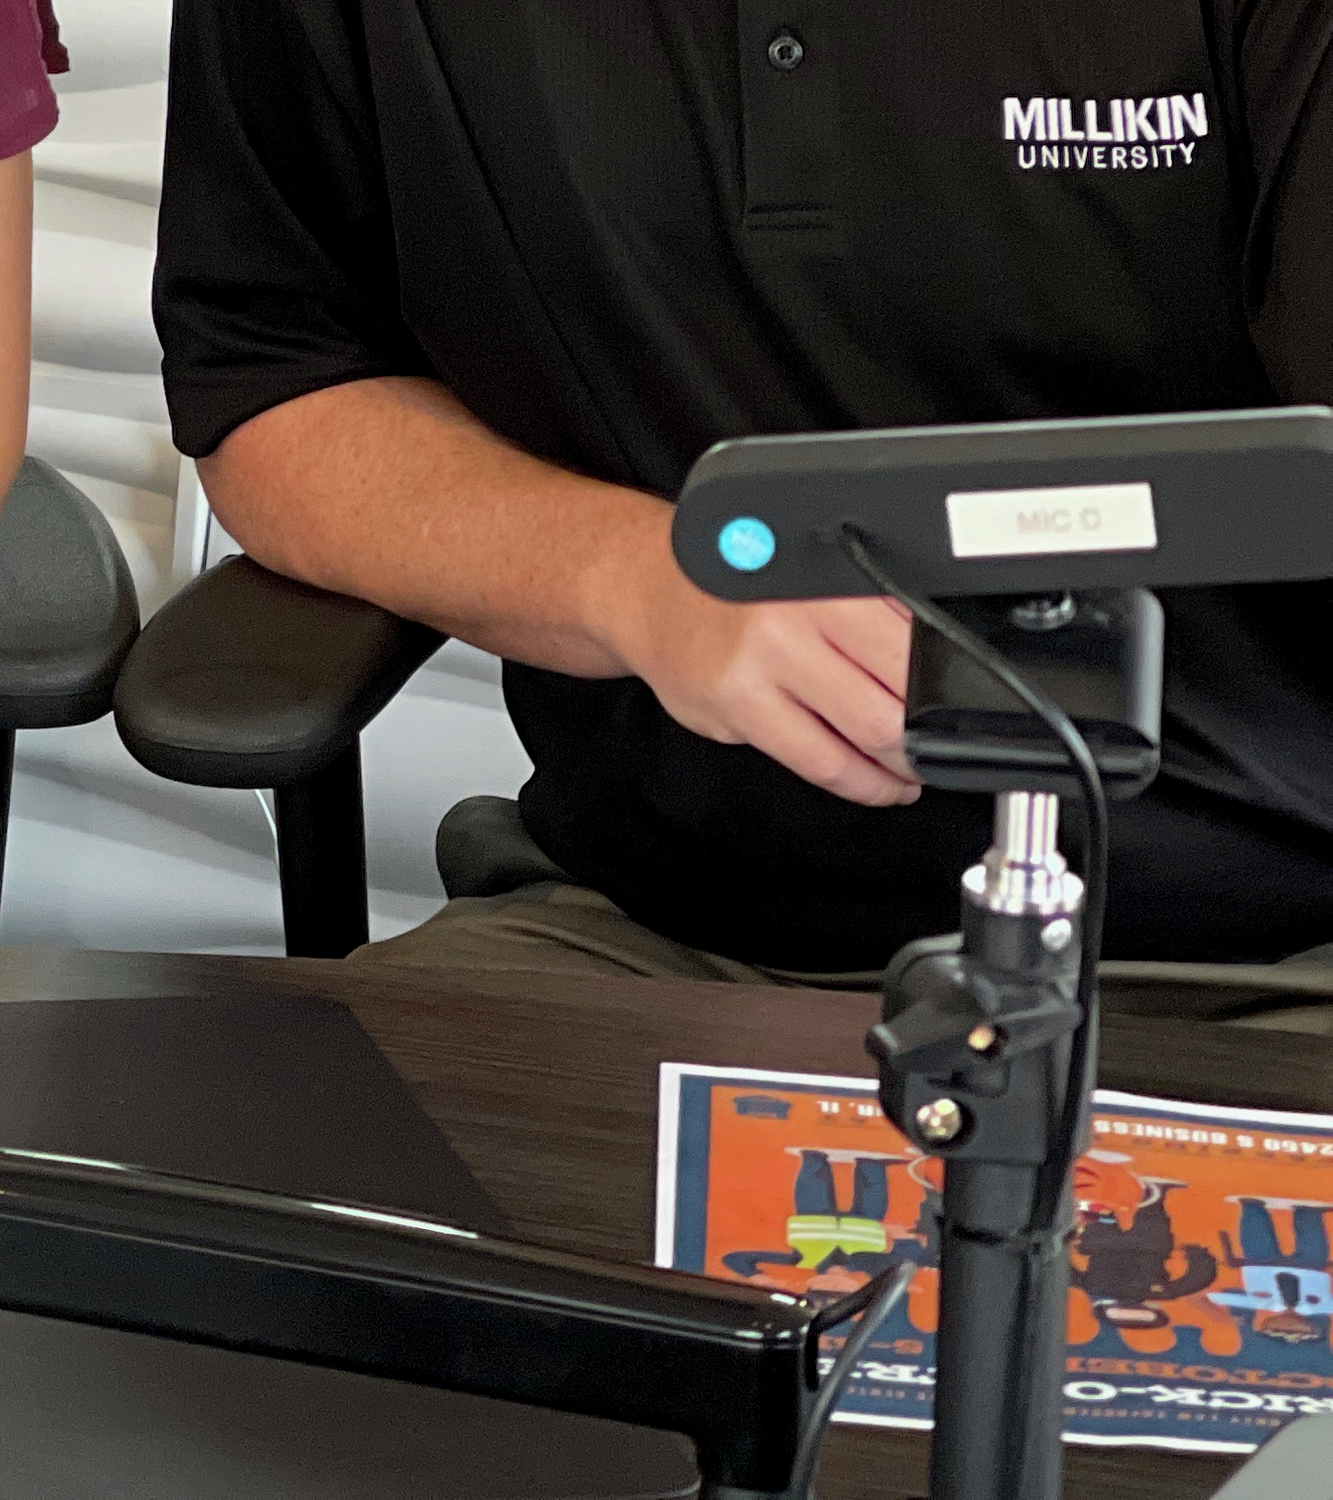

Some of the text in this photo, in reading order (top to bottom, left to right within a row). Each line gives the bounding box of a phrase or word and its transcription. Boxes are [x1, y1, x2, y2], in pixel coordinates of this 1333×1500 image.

[1002, 92, 1208, 142] MILLIKIN
[1018, 142, 1196, 169] UNIVERSITY
[1016, 508, 1072, 534] MIC
